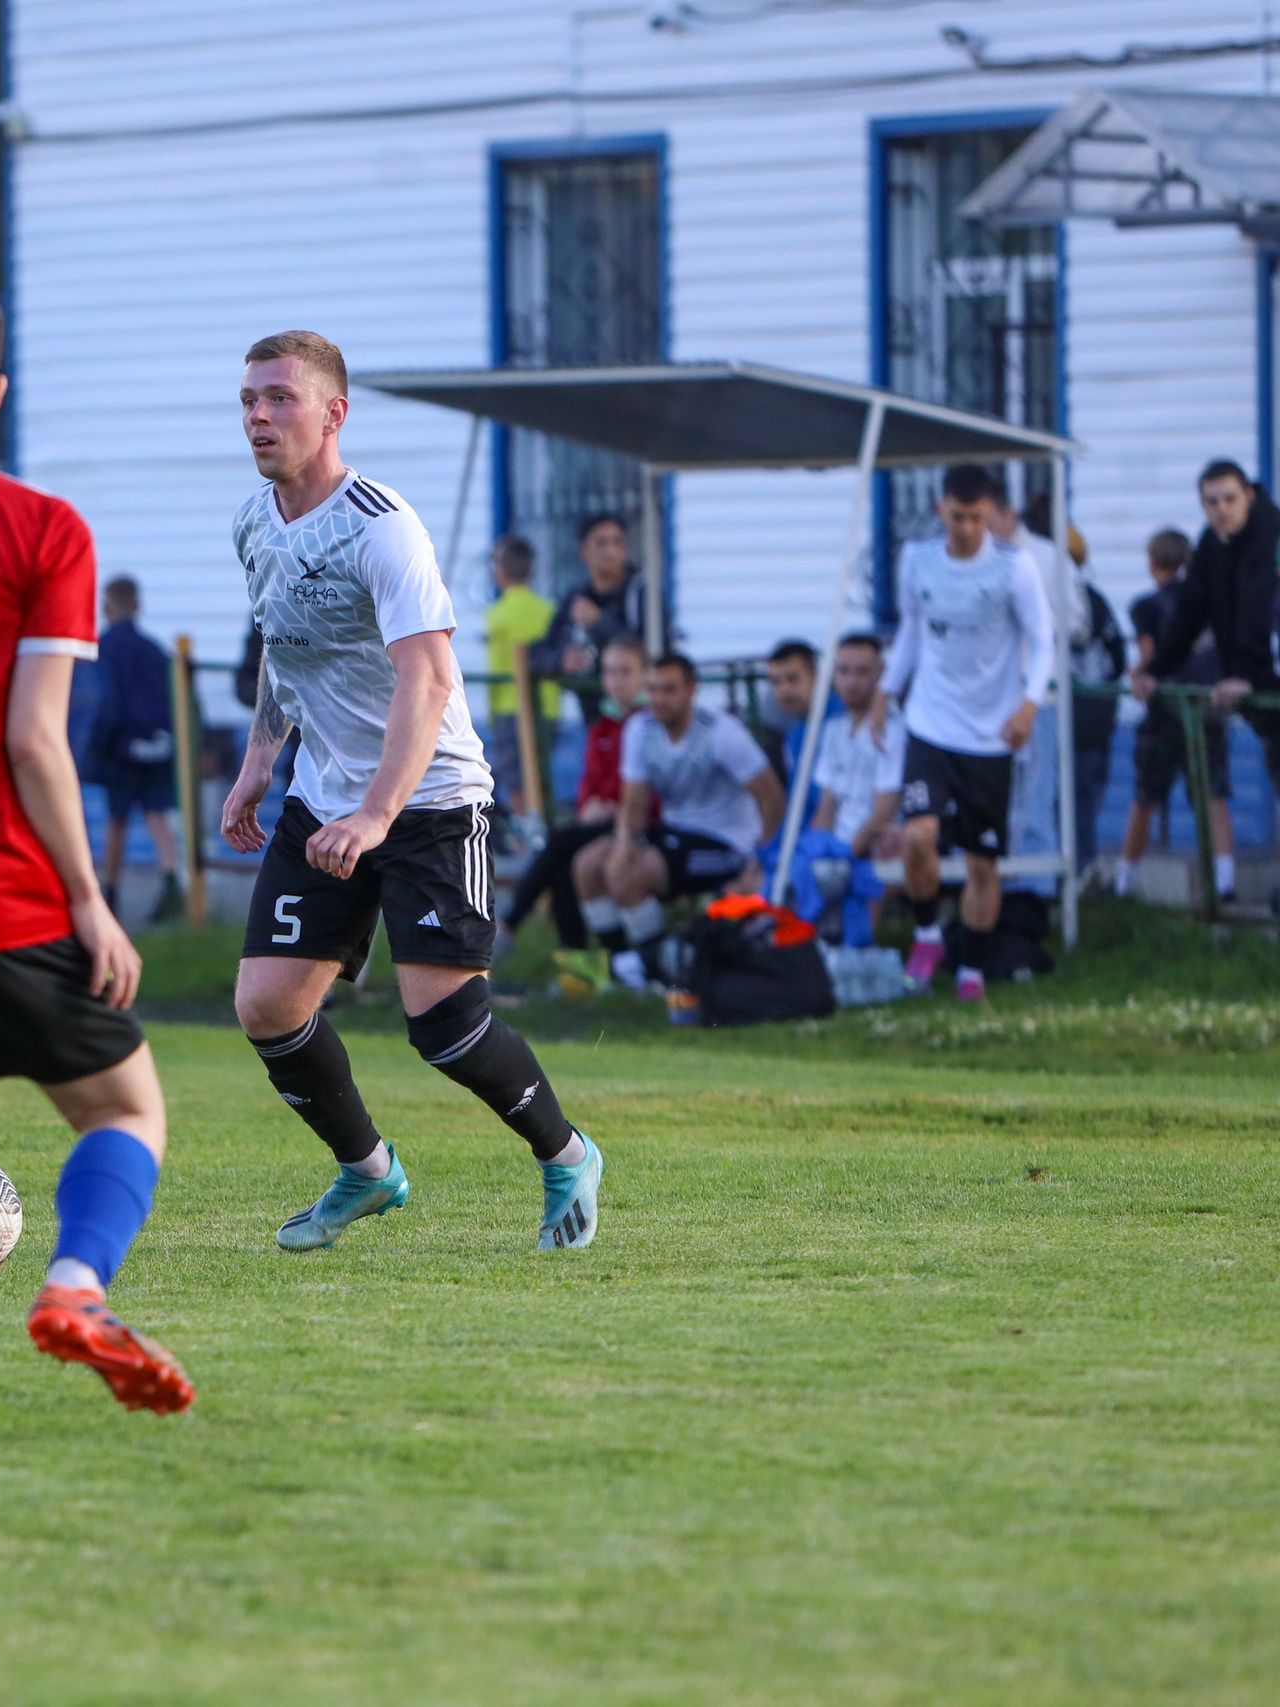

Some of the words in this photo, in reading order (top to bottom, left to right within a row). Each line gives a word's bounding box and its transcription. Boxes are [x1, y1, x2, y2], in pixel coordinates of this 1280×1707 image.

[287, 583, 337, 600] ЧАЙКА
[295, 599, 327, 607] САМАРА
[286, 635, 309, 646] Tab
[272, 894, 303, 944] 5
